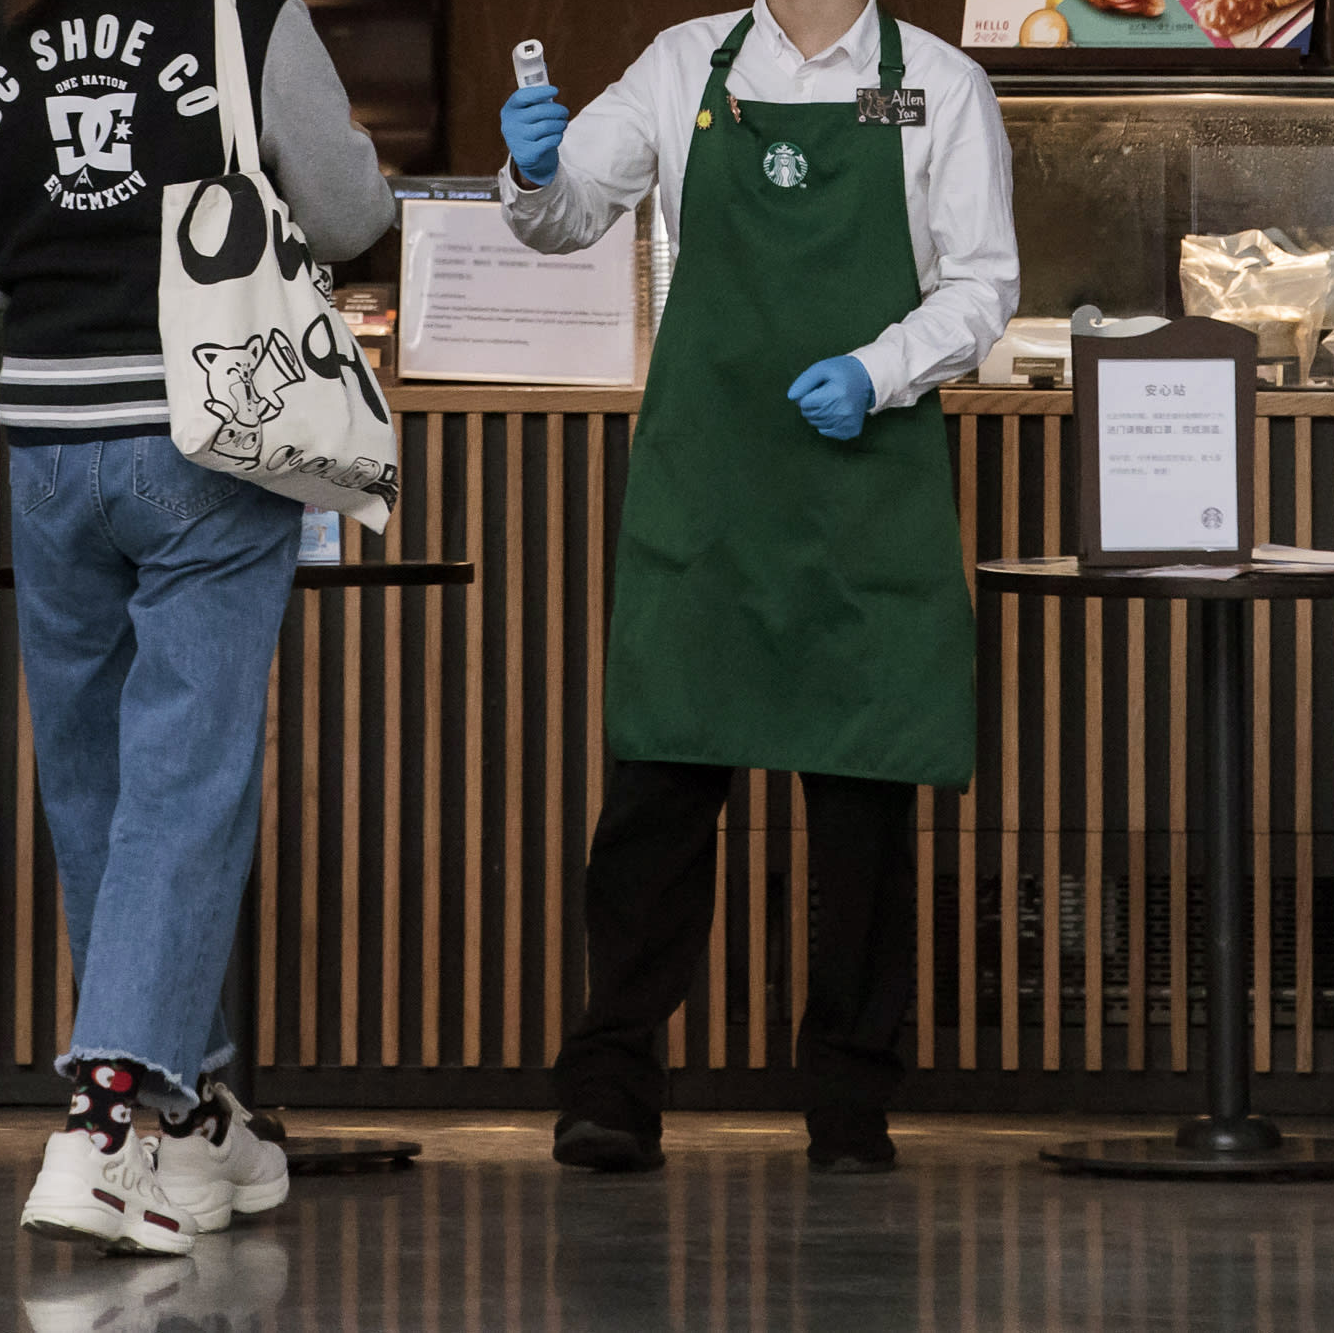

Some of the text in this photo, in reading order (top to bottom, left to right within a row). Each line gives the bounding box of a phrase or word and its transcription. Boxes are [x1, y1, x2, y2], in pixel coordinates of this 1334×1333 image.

[975, 20, 1010, 31] HELLO
[30, 14, 155, 72] SHOE
[158, 53, 218, 117] CO
[55, 74, 129, 94] ONE NATION
[891, 89, 925, 107] Allen
[60, 170, 147, 211] MCMXCIV
[1145, 384, 1186, 397] 安心站
